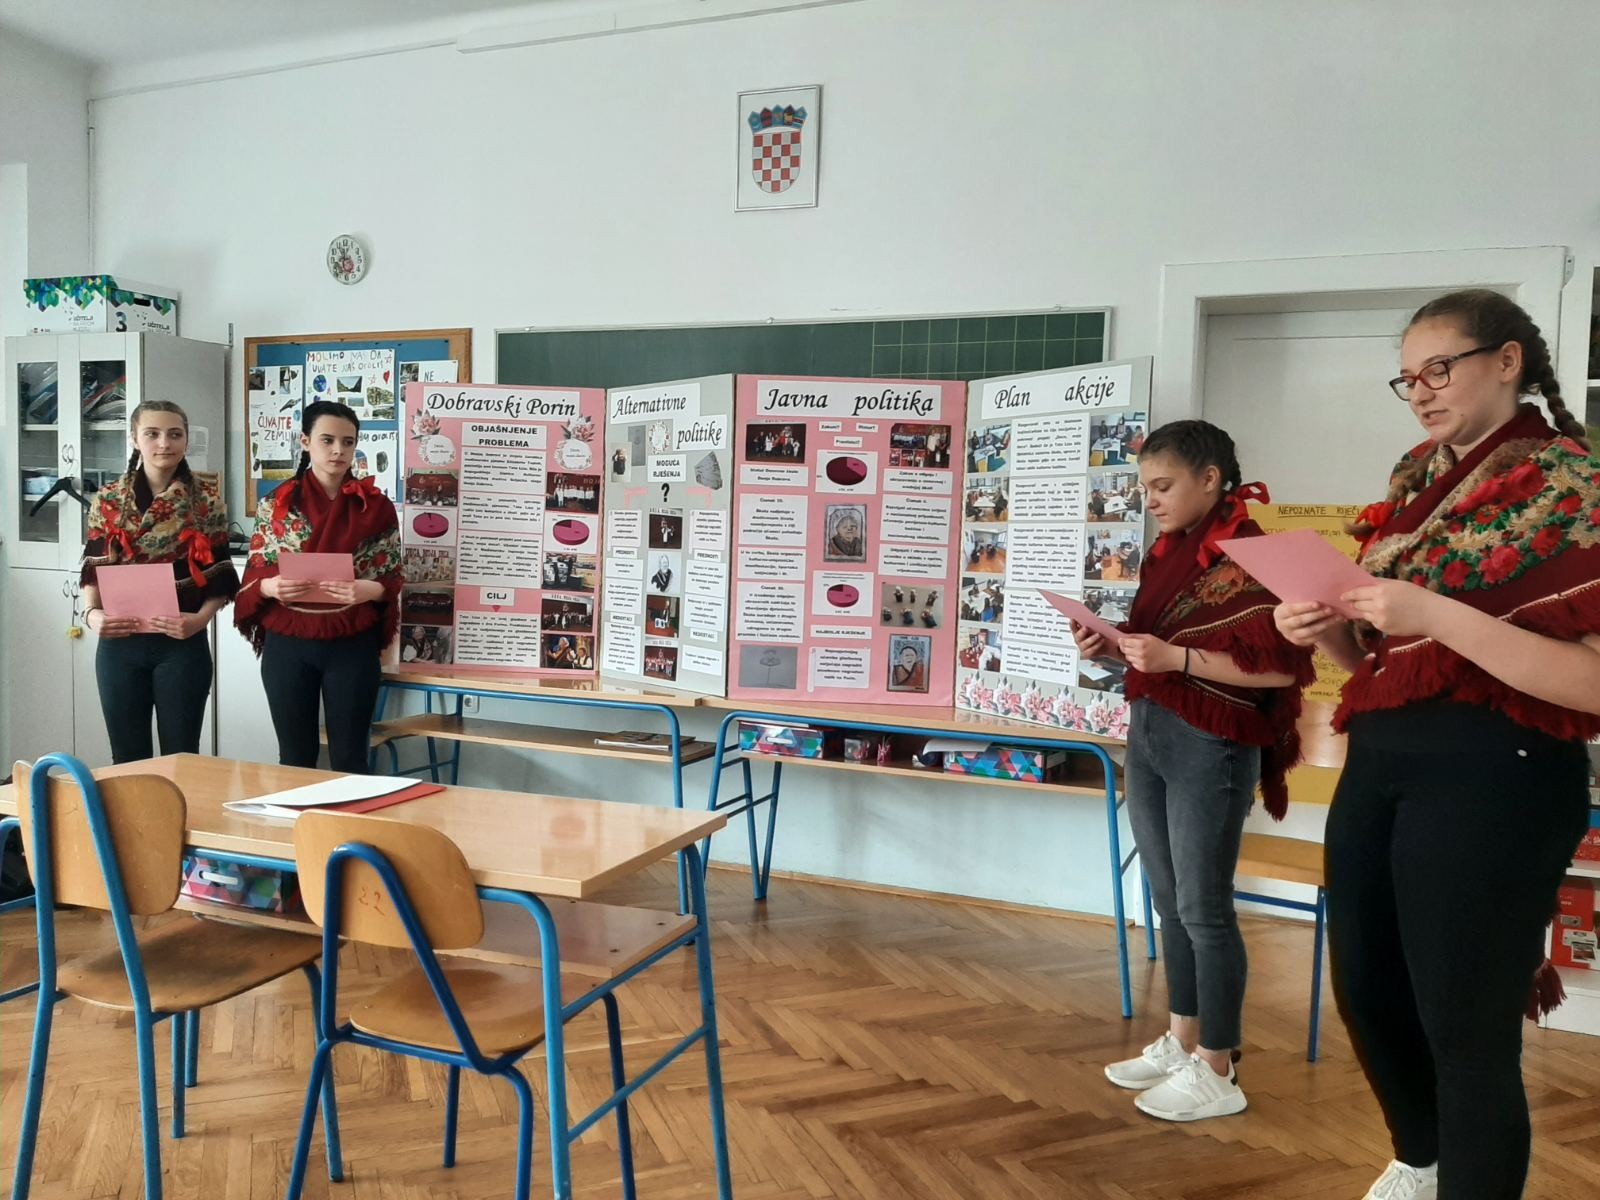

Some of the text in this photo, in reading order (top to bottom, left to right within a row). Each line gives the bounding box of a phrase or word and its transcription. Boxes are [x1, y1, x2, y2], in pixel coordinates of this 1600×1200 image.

[115, 311, 127, 332] 3
[307, 351, 344, 362] MOLIMO
[424, 370, 434, 382] NE
[764, 388, 934, 417] Javna politika
[994, 376, 1115, 409] Plan akcije
[427, 391, 576, 418] Dobravski Porin
[612, 393, 687, 419] Alternativne
[471, 425, 538, 435] OBJAŠNJENJE
[676, 420, 722, 449] politike
[479, 438, 530, 447] PROBLEMA
[661, 482, 670, 503] ?
[1278, 505, 1327, 515] NEPOZNATE
[486, 592, 507, 600] CILJ
